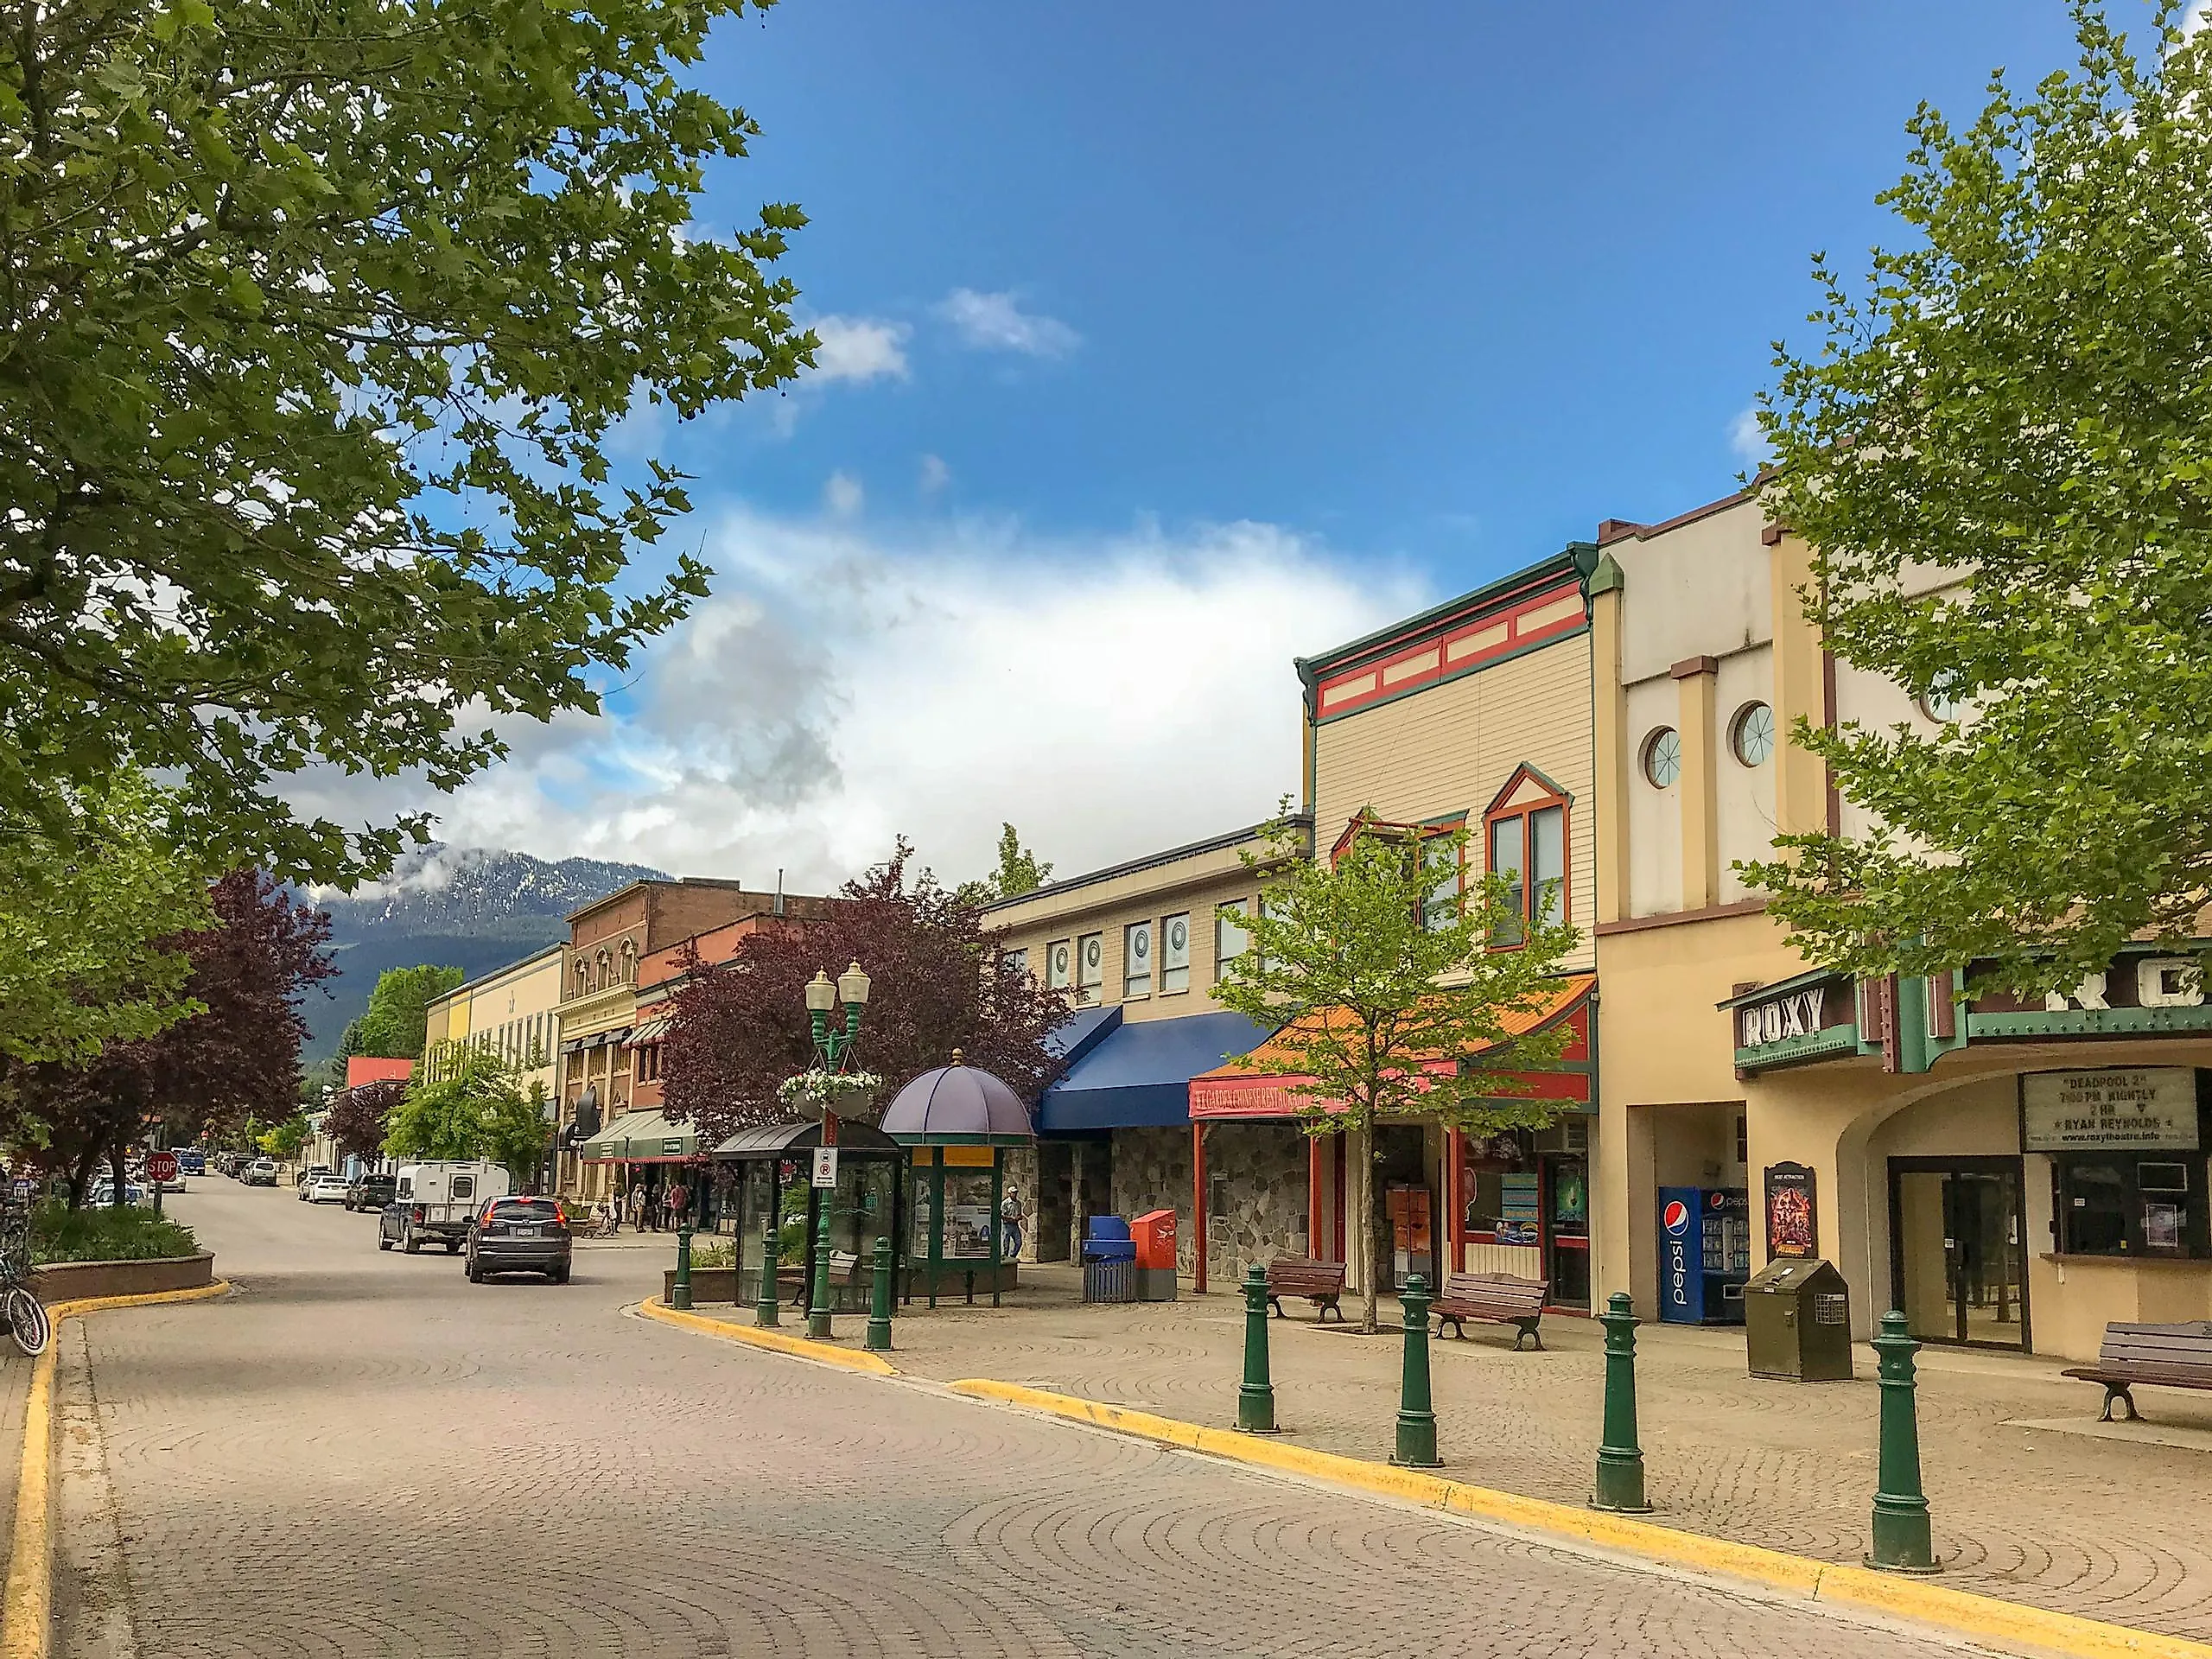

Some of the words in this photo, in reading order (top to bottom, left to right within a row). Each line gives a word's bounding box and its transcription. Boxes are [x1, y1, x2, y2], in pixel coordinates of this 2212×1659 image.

[1742, 987, 1825, 1047] ROXY
[149, 1160, 175, 1173] STOP
[1669, 1240, 1688, 1306] pepsi
